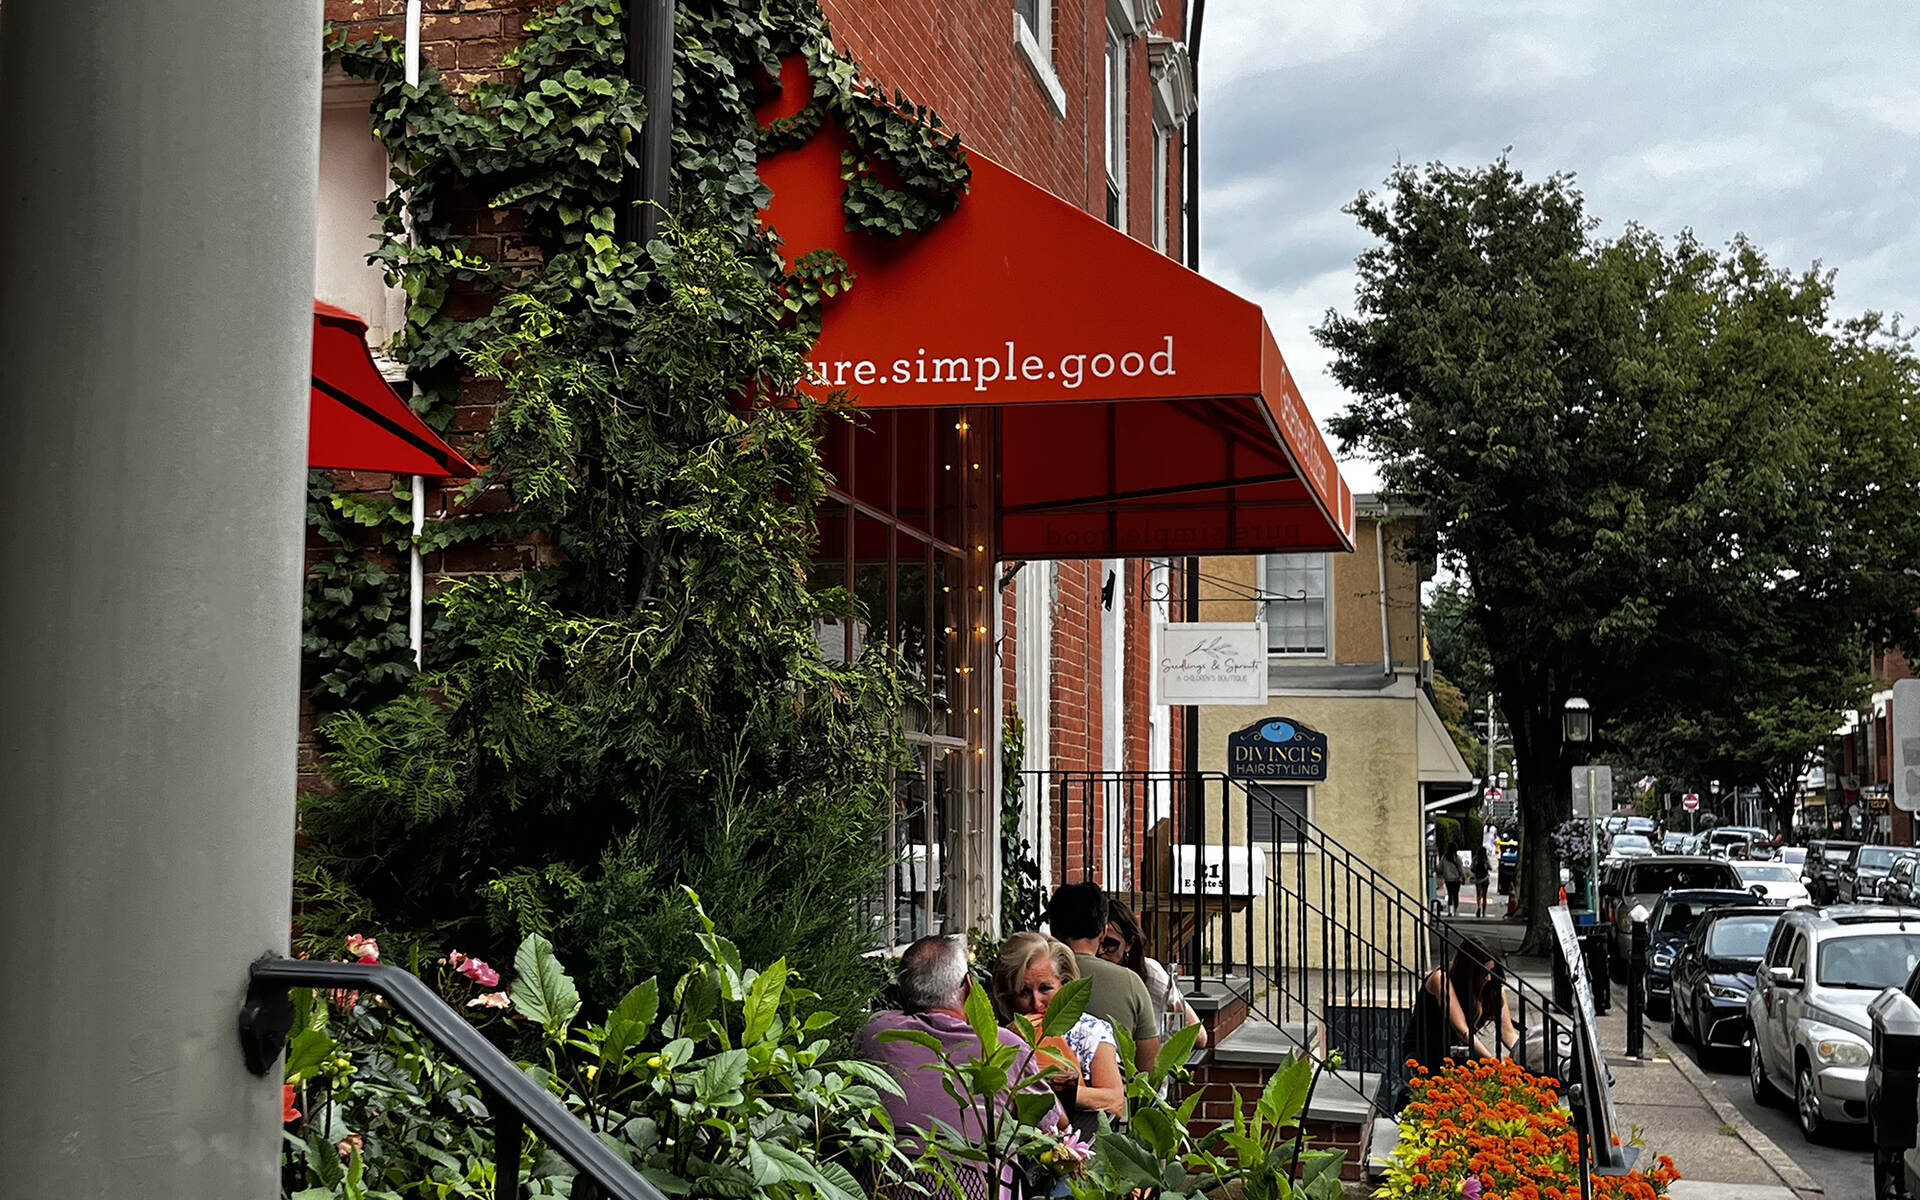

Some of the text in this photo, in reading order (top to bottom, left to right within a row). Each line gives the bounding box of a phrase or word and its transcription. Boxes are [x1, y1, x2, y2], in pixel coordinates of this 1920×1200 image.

[794, 336, 1176, 391] ure.simple.good
[1211, 660, 1220, 671] &
[1235, 745, 1322, 763] DIVINCI'S
[1236, 764, 1320, 776] HAIRSTYLING
[1184, 879, 1191, 887] E
